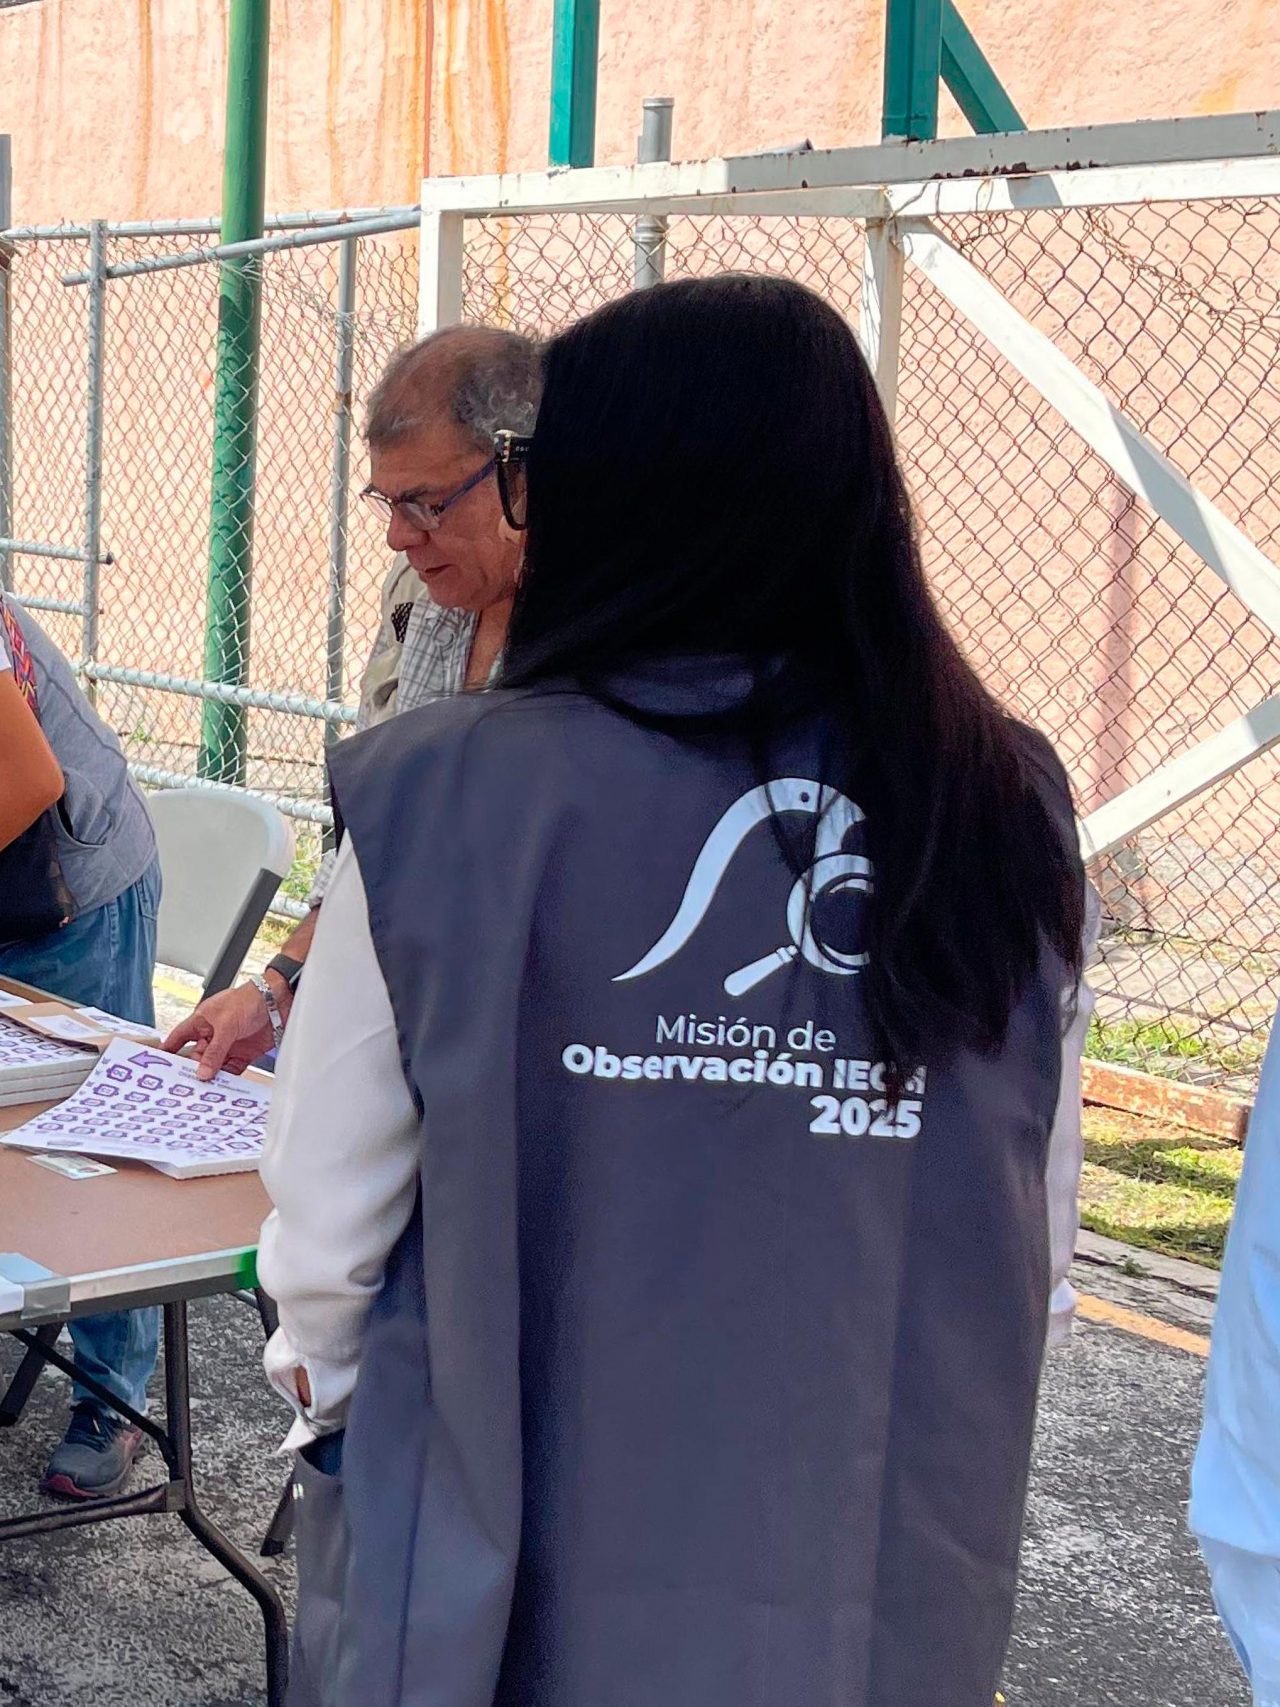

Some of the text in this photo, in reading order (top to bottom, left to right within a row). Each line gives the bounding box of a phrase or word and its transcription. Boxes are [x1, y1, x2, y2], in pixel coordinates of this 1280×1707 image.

[655, 1013, 838, 1053] Misión de
[561, 1043, 824, 1088] Observación
[809, 1094, 923, 1139] 2025
